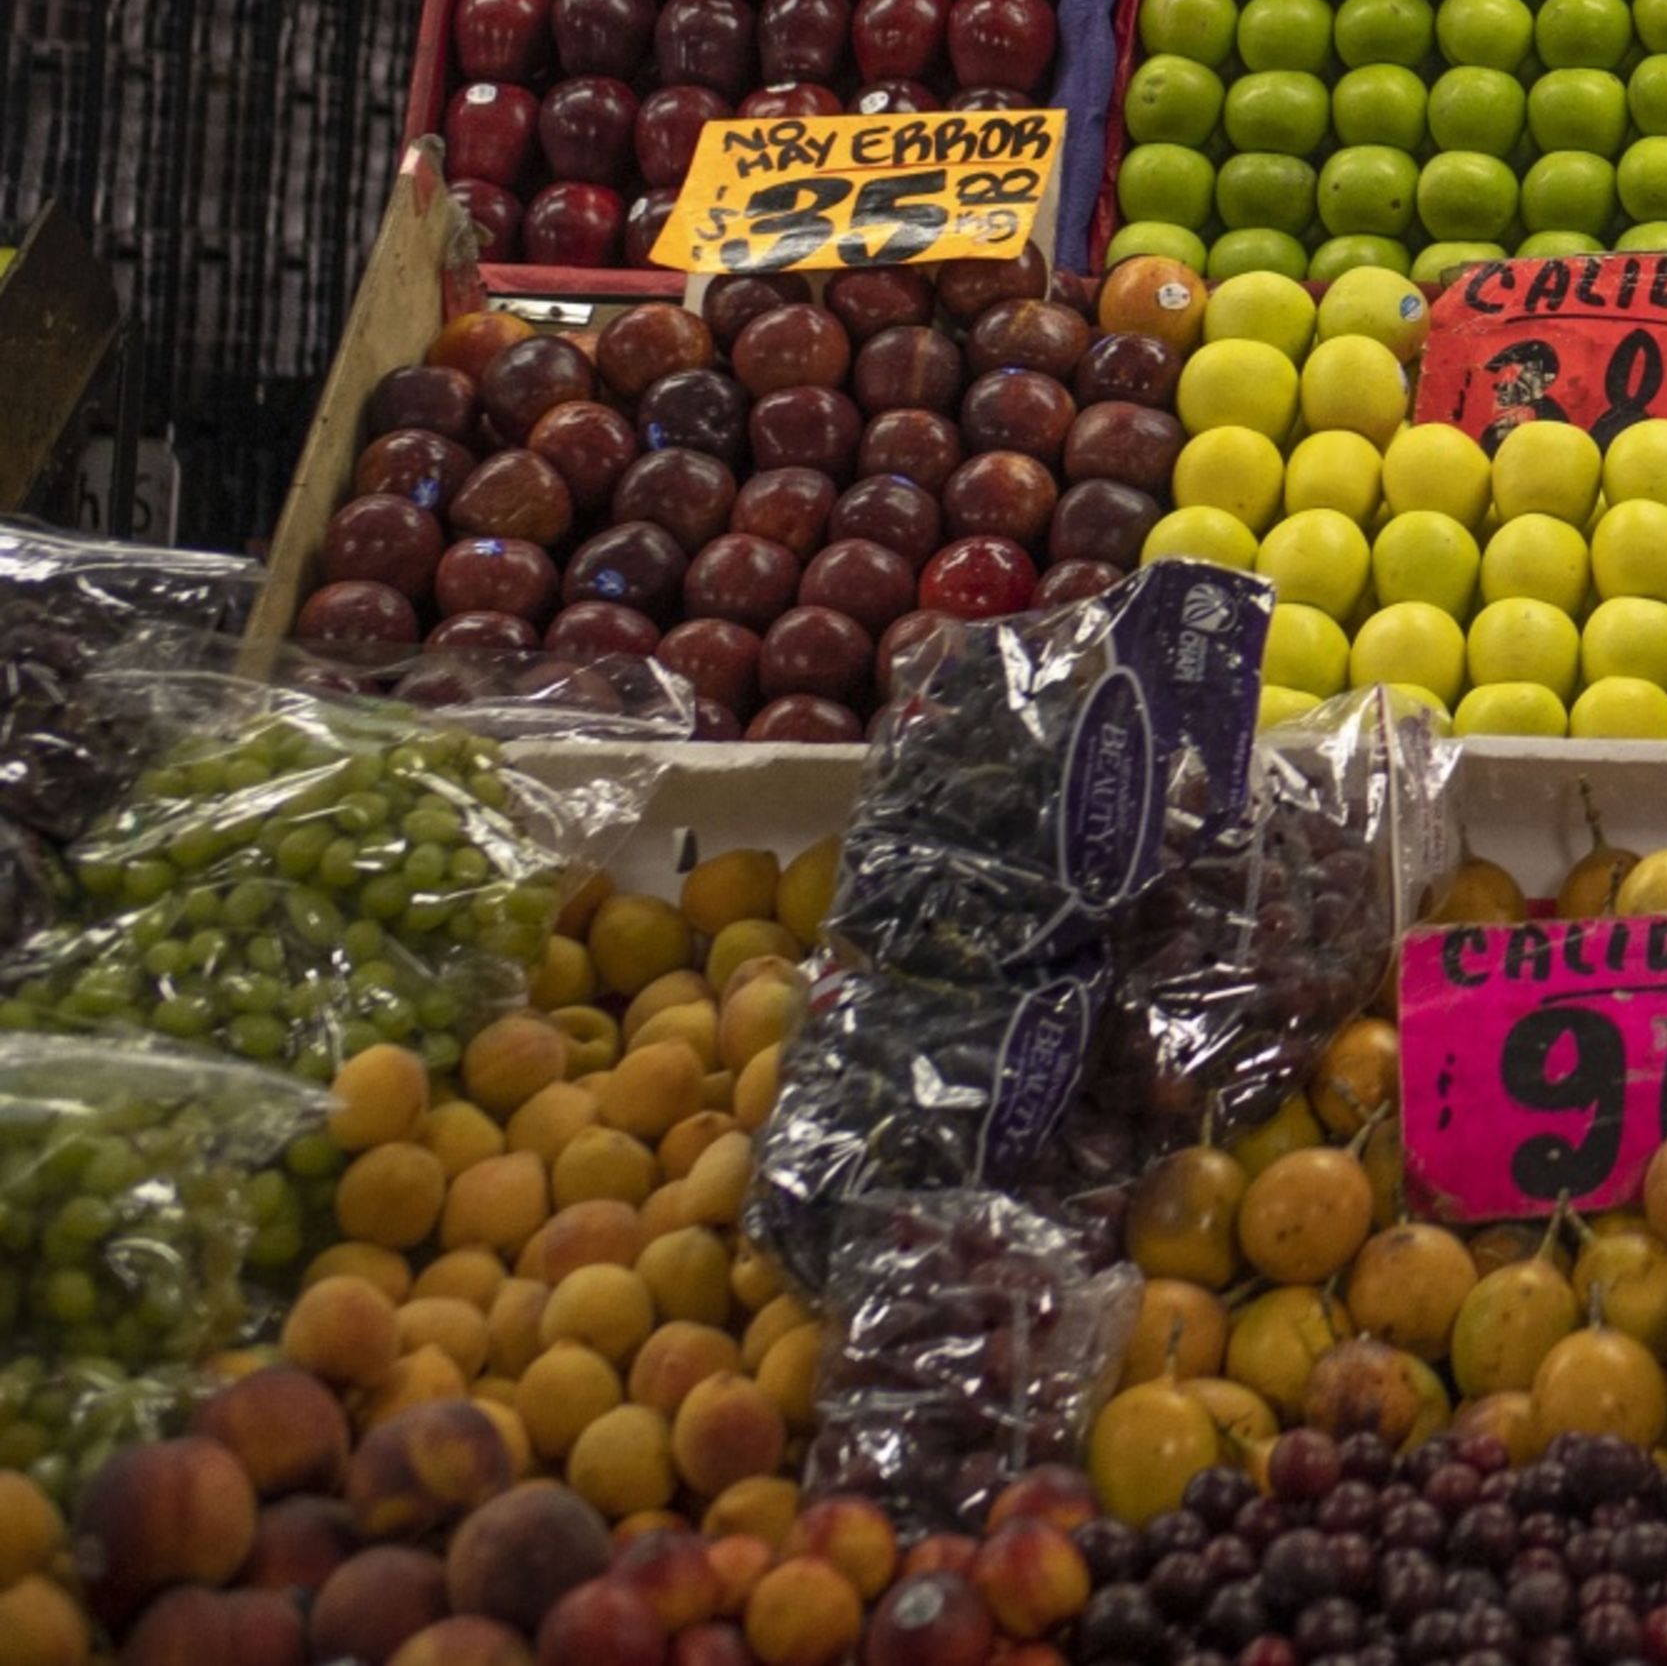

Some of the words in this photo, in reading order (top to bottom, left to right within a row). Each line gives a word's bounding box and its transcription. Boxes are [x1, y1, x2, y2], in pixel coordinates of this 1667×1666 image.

[724, 121, 807, 153] NO
[736, 131, 836, 178] HAY
[851, 115, 1052, 165] ERROR
